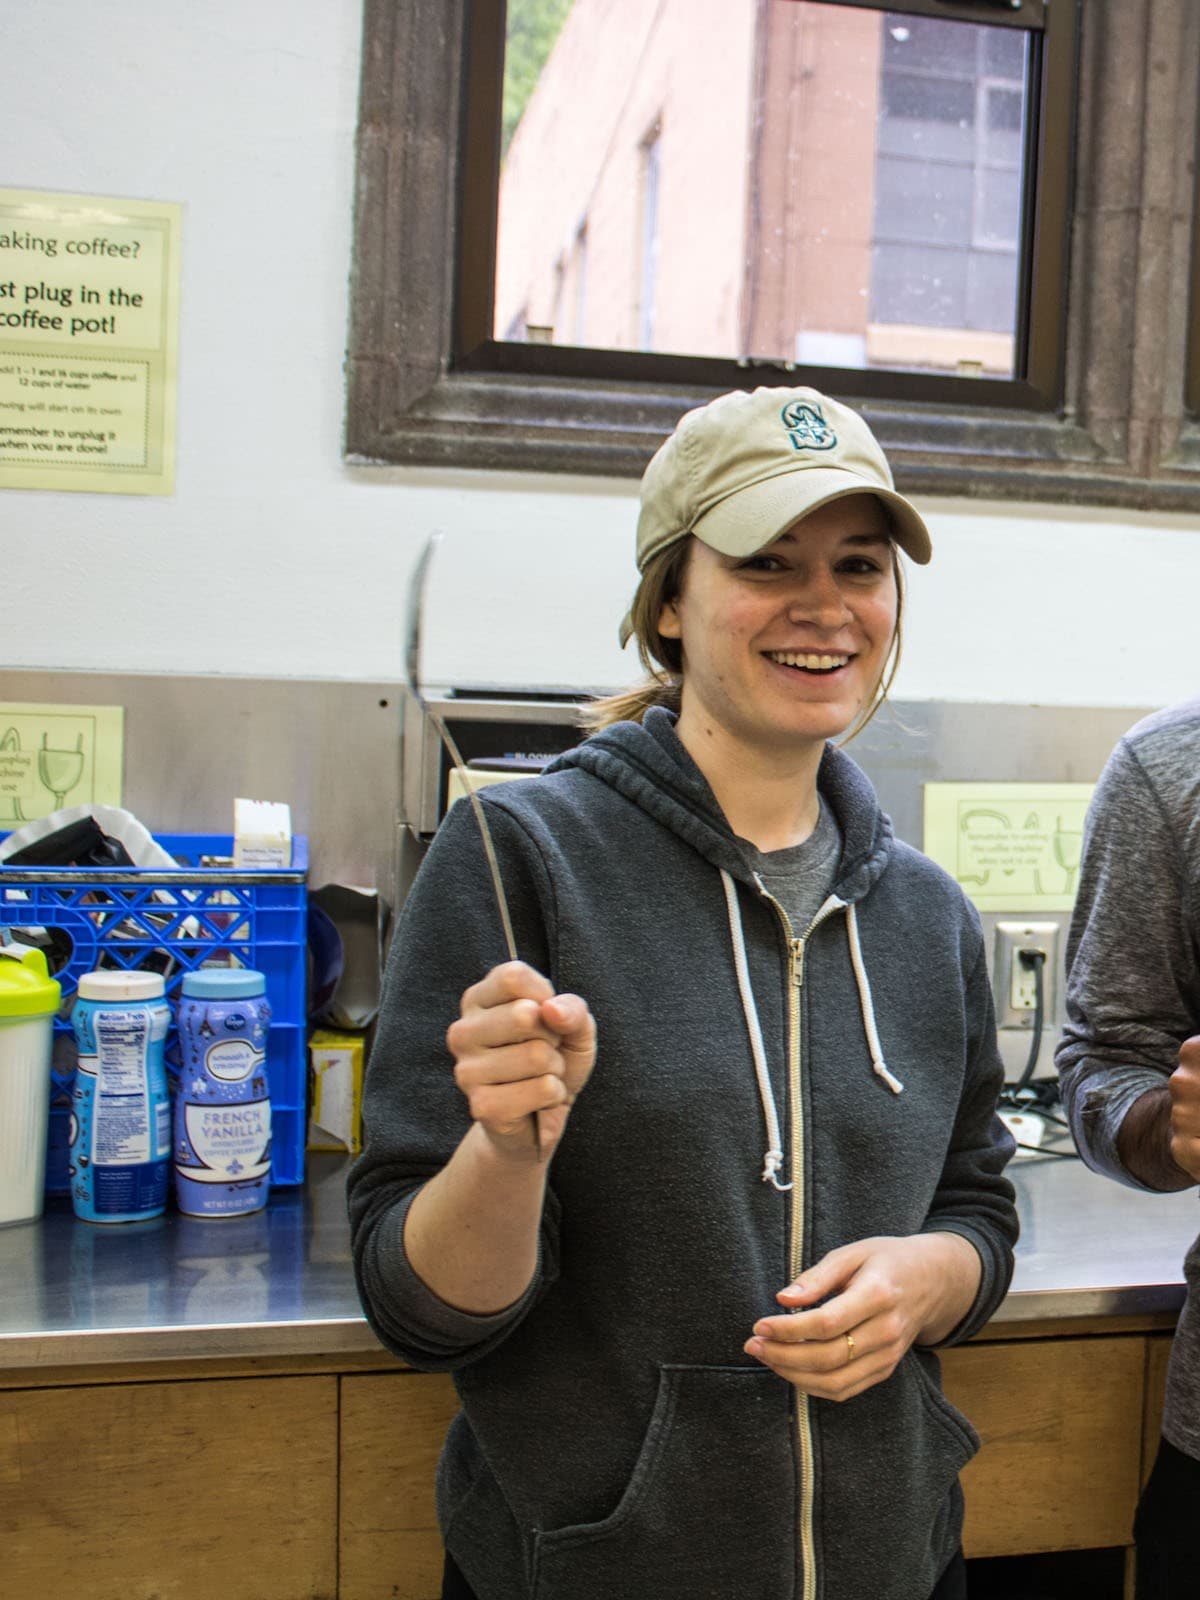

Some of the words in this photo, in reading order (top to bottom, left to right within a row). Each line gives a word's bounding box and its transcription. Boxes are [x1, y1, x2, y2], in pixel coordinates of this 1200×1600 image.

[65, 238, 141, 259] coffee?
[25, 282, 72, 307] plug
[80, 285, 101, 304] in
[108, 287, 143, 307] the
[71, 316, 115, 336] pot!
[39, 369, 56, 377] and
[69, 371, 89, 379] cups
[91, 371, 118, 380] coffee
[31, 380, 51, 389] cups
[53, 428, 65, 438] to
[68, 430, 105, 442] unplug
[31, 443, 53, 452] you
[56, 444, 73, 452] are
[203, 1110, 260, 1125] FRENCH
[202, 1124, 263, 1138] VANILLA
